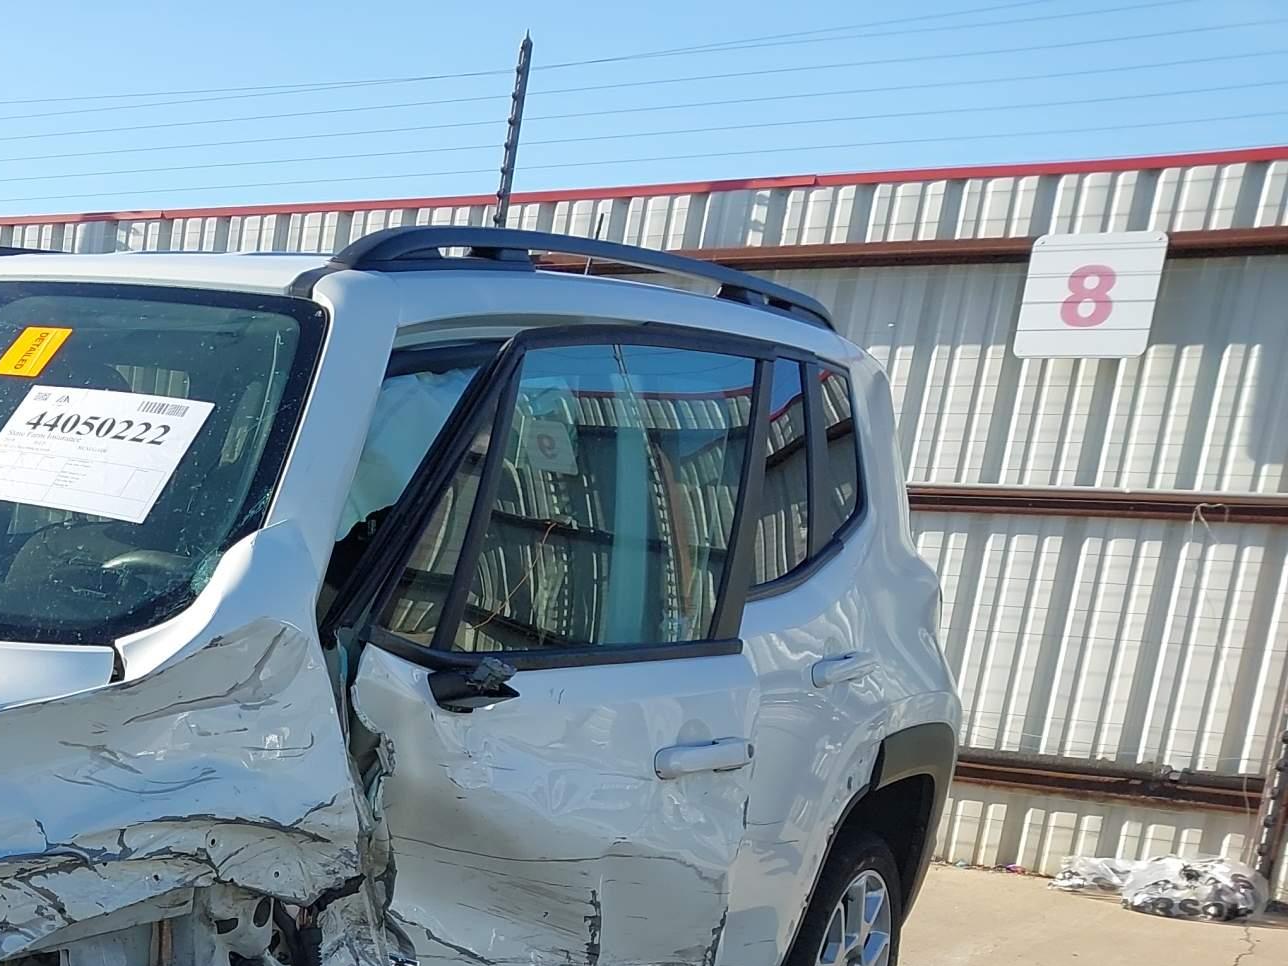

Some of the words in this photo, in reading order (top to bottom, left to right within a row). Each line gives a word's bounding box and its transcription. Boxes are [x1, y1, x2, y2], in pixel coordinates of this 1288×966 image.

[1059, 265, 1117, 328] 8
[14, 332, 49, 370] DETAILED
[25, 411, 171, 445] 44050222
